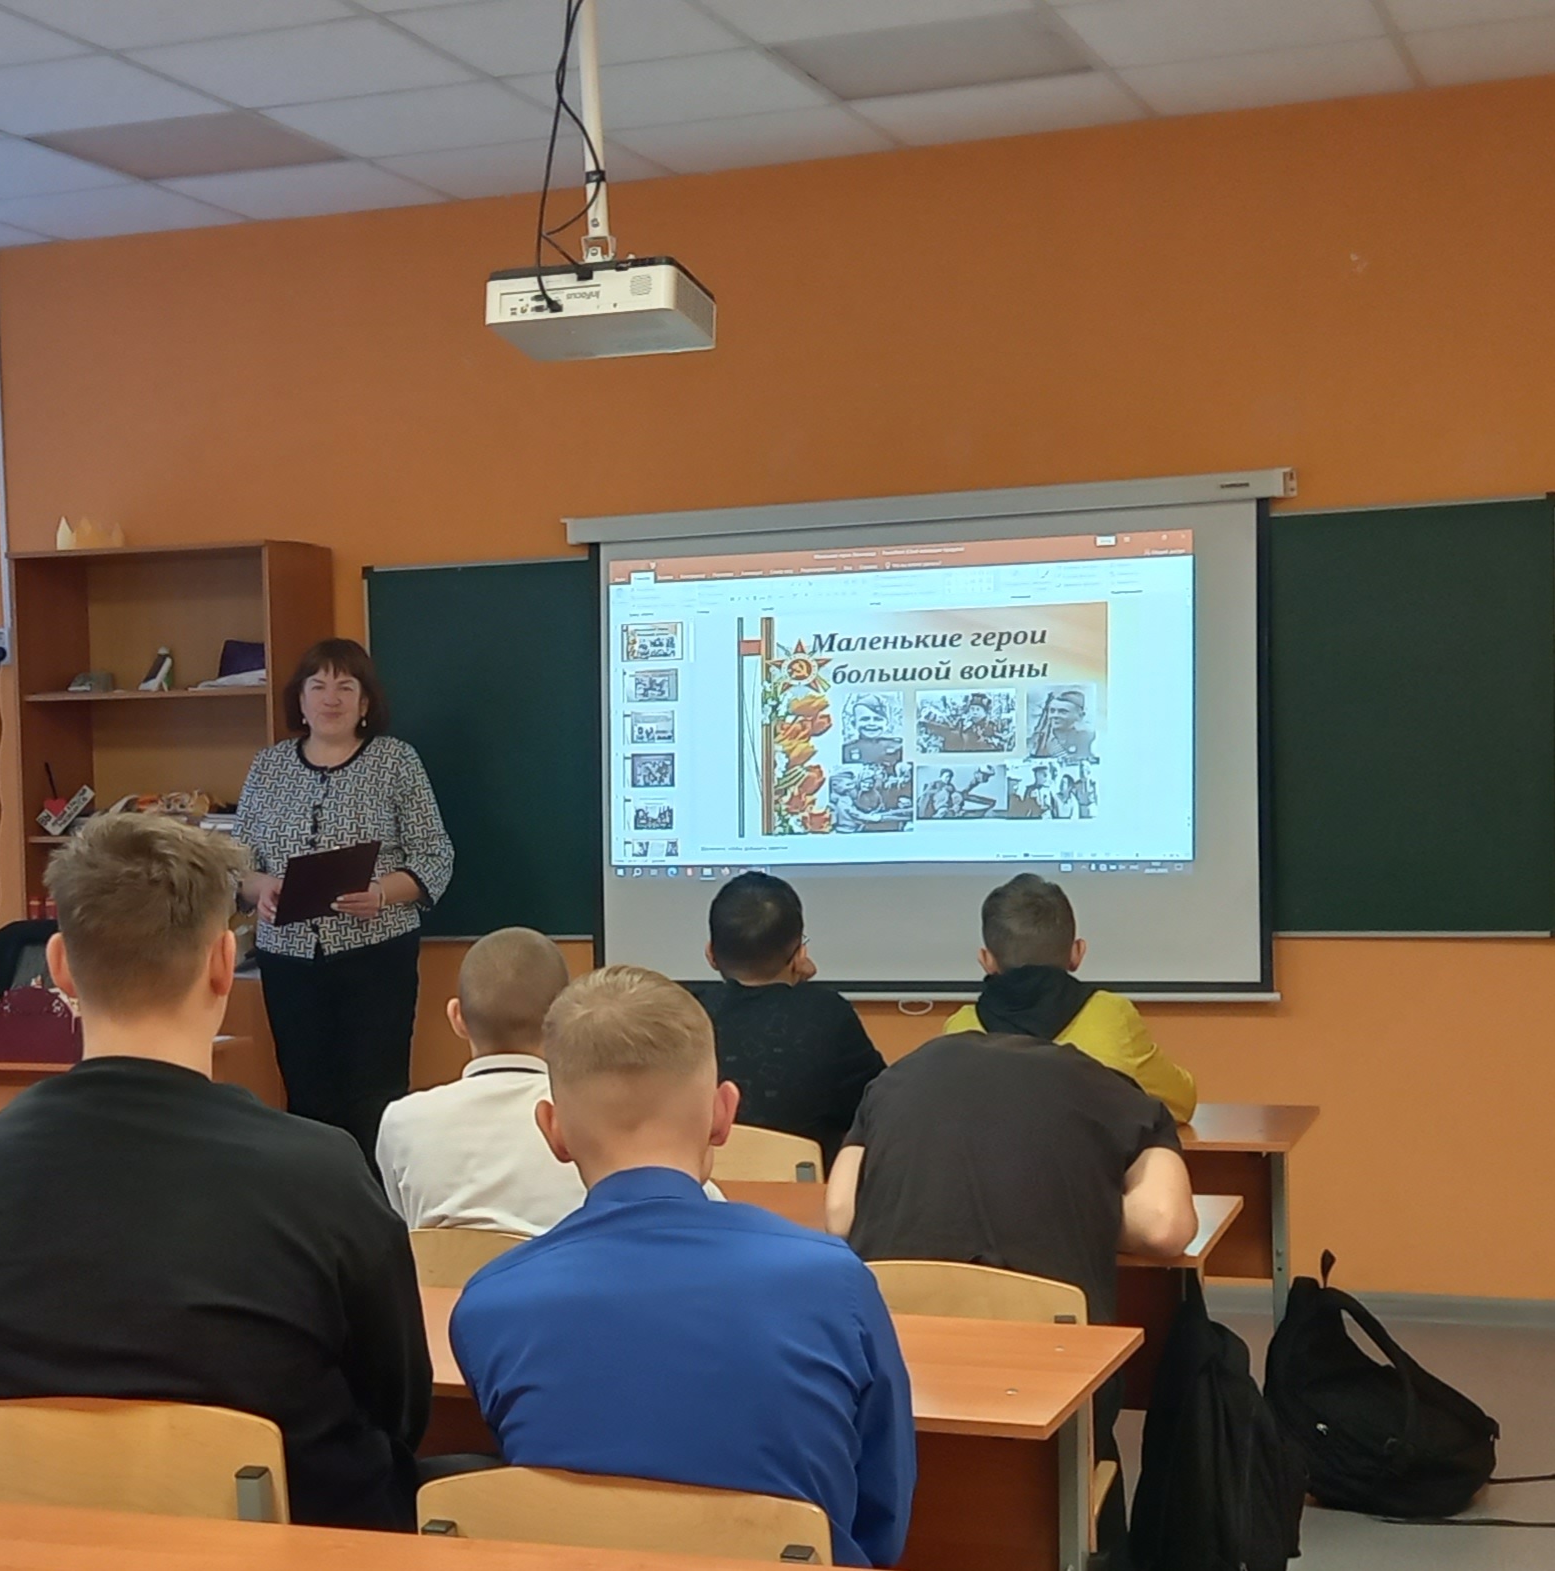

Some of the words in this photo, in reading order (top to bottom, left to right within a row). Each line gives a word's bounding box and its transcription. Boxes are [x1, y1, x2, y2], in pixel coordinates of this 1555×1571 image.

[811, 632, 963, 654] Маленькие
[970, 628, 1047, 652] герои
[831, 659, 952, 685] большой
[959, 657, 1049, 681] войны
